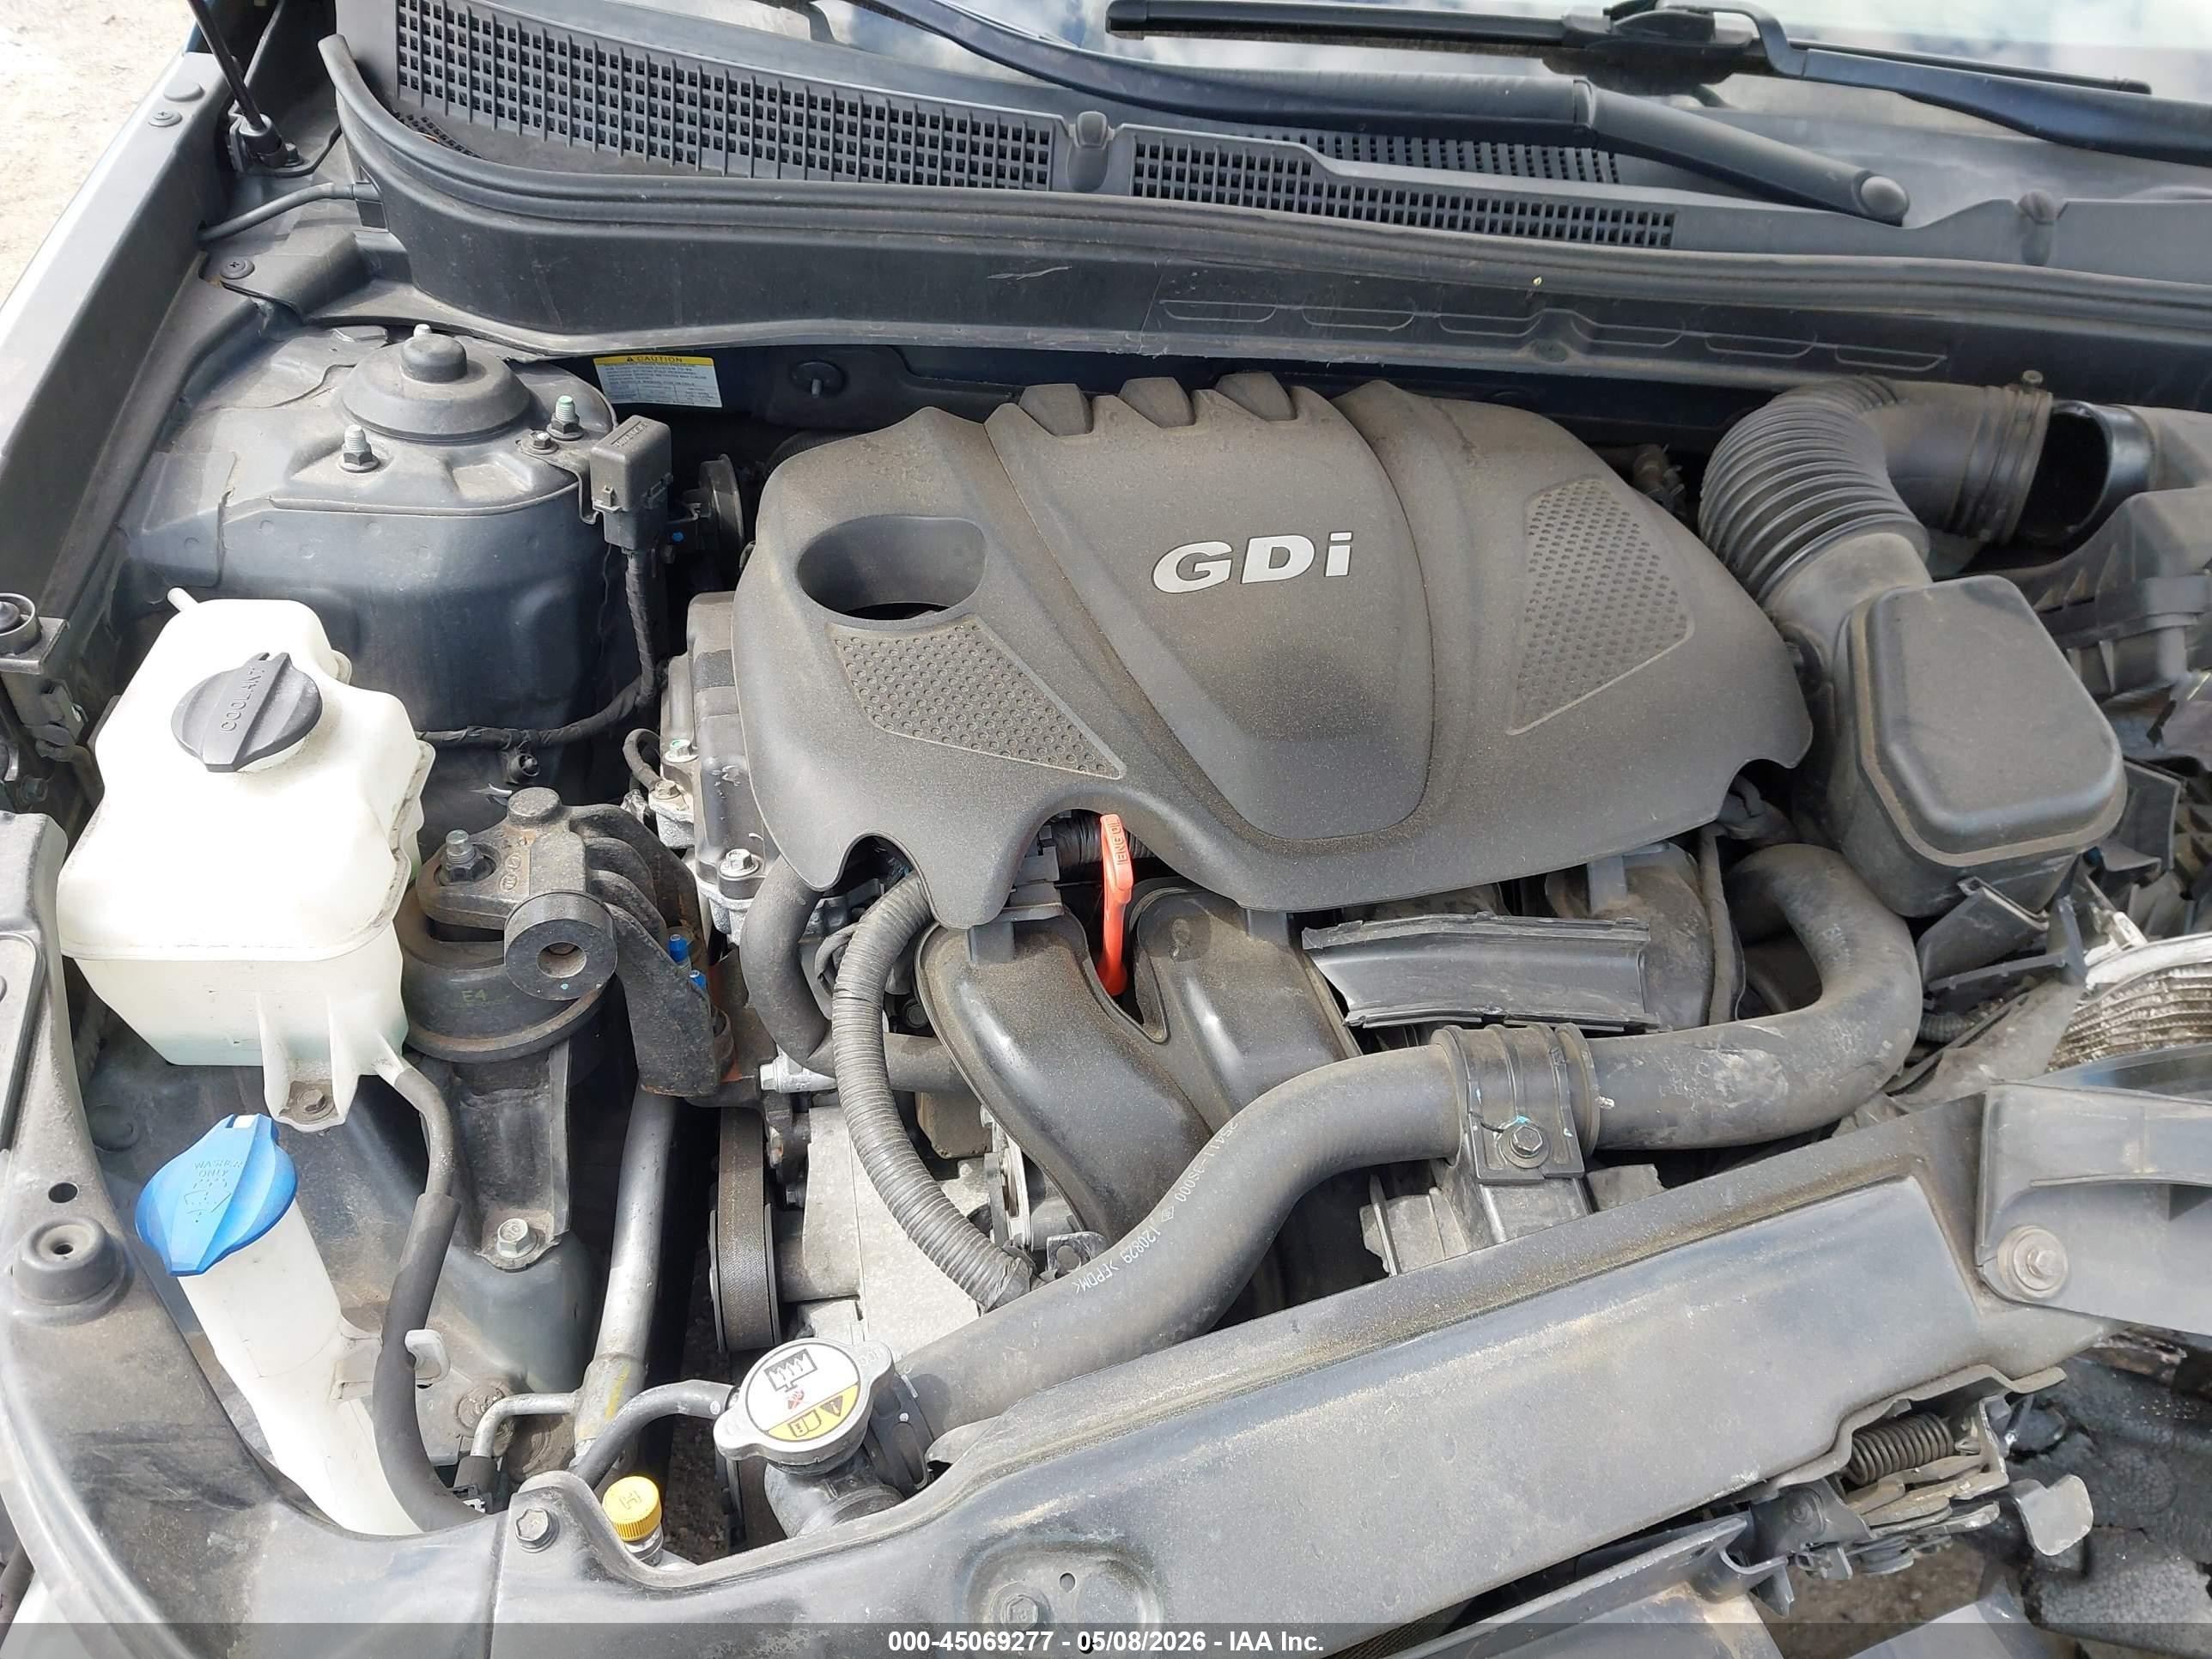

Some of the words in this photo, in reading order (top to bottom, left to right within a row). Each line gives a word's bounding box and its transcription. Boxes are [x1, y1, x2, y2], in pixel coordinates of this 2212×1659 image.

[1152, 531, 1353, 594] GDi
[220, 665, 265, 732] COOLANT
[198, 1169, 228, 1178] ONLY
[1120, 1224, 1161, 1264] 120829
